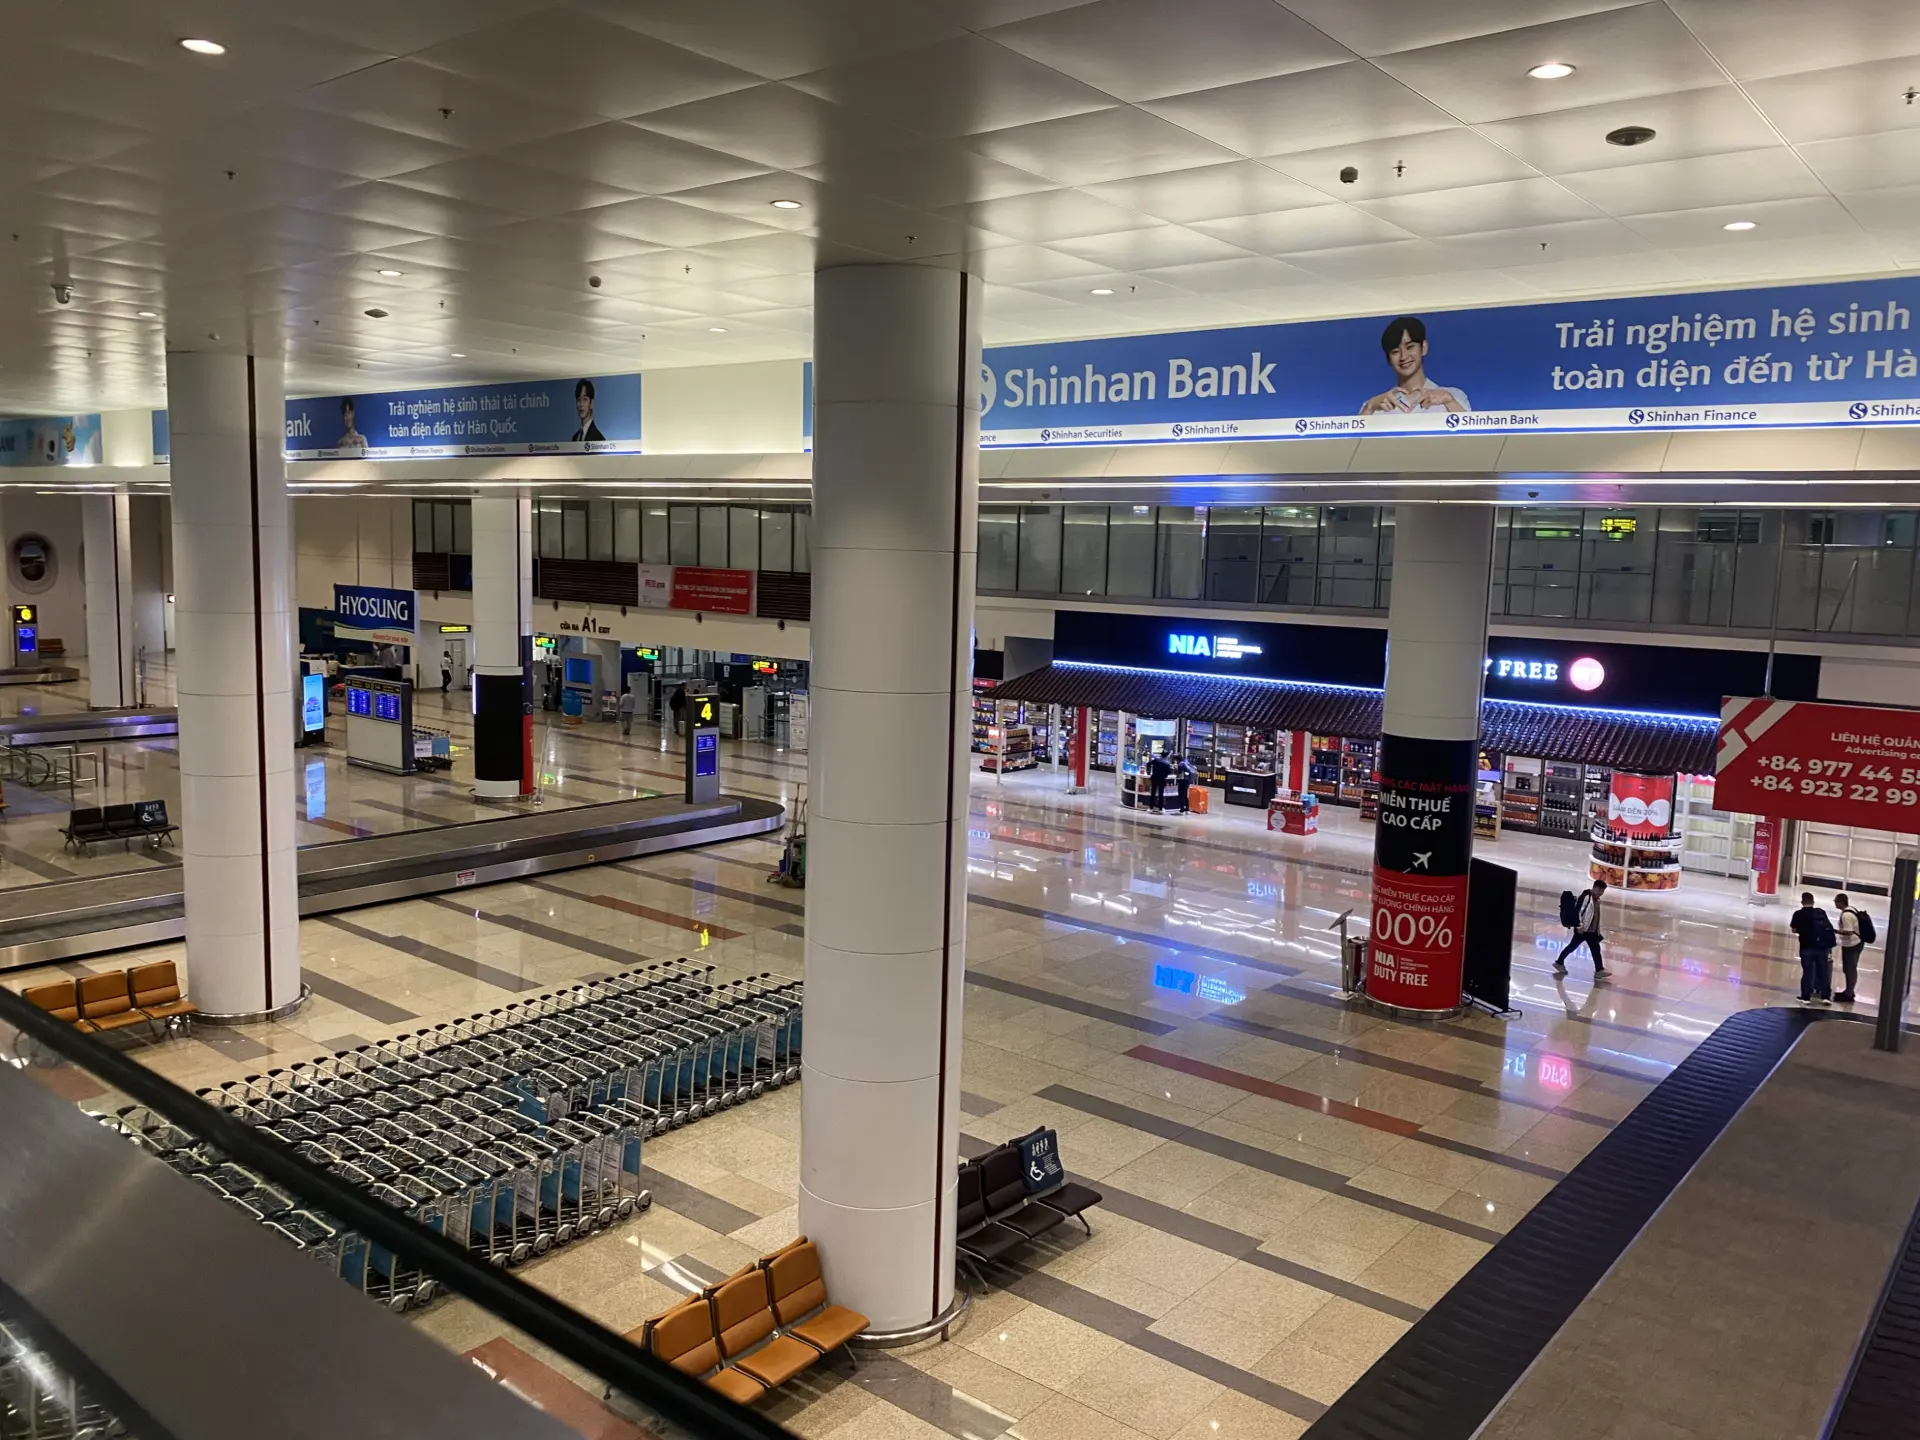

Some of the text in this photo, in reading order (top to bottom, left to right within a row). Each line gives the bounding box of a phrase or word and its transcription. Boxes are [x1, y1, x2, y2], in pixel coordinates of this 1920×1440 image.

[1555, 301, 1910, 354] Trải nghiệm hệ sinh
[1003, 352, 1277, 408] Shinhan Bank
[1551, 349, 1918, 393] toàn diện đến từ Hà
[407, 400, 441, 420] nghiệm
[443, 398, 455, 415] hệ
[458, 395, 478, 412] sinh
[519, 391, 549, 408] chính
[286, 413, 312, 437] ank
[1309, 419, 1365, 430] Shinhan DS
[1462, 414, 1539, 426] Shinhan Bank
[1646, 410, 1757, 422] Shinhan Finance
[490, 416, 517, 438] Quốc
[1051, 429, 1122, 440] Shinhan Securities
[1185, 424, 1238, 435] Shinhan Life
[339, 595, 408, 621] HYOSUNG
[582, 617, 596, 633] A1
[1168, 633, 1211, 657] NIA
[1498, 659, 1558, 680] FREE
[701, 703, 712, 720] 4
[1831, 732, 1859, 744] LIÊN
[1863, 734, 1881, 748] HỆ
[1845, 746, 1907, 760] Advertising
[1757, 755, 1802, 773] +84
[1808, 759, 1853, 778] 977
[1859, 764, 1894, 782] 44
[1750, 775, 1918, 806] +84 923 22 99
[1380, 790, 1452, 813] MIỄN THUẾ
[1382, 811, 1442, 831] CAO CẤP
[1399, 891, 1420, 902] THUẾ
[1421, 894, 1439, 903] CAO
[1440, 893, 1455, 903] CẤP
[1403, 902, 1431, 912] CHÍNH
[1375, 949, 1395, 968] NIA
[1373, 963, 1428, 987] DUTY FREE
